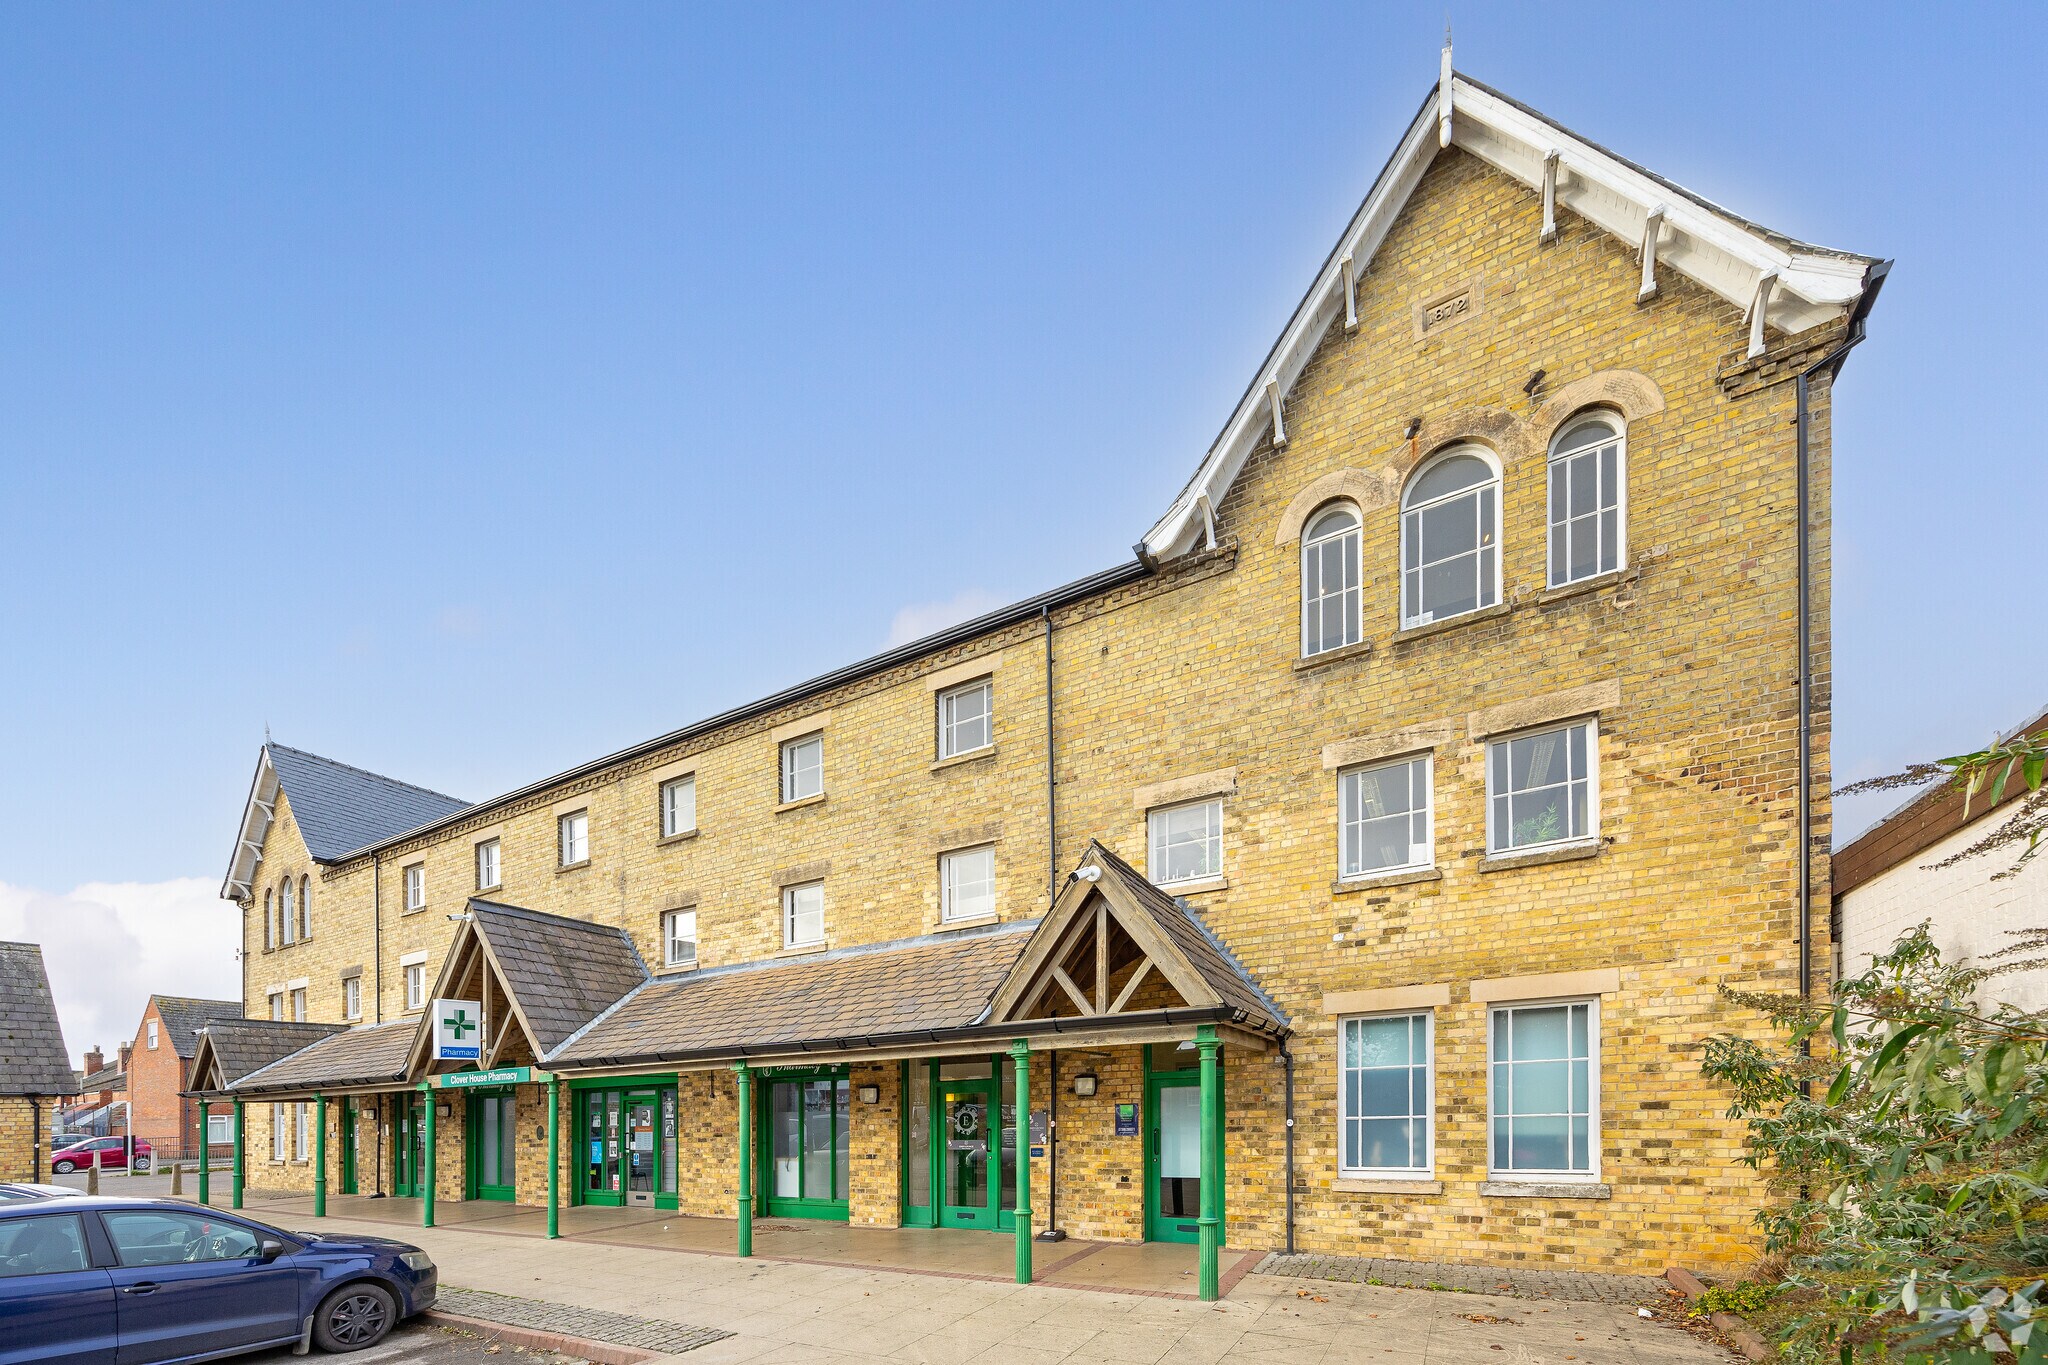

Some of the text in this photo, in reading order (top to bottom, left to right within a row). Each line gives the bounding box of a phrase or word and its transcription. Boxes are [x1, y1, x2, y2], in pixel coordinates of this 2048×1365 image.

[441, 1048, 479, 1057] Pharmacy
[450, 1071, 518, 1085] Clover House Pharmacy
